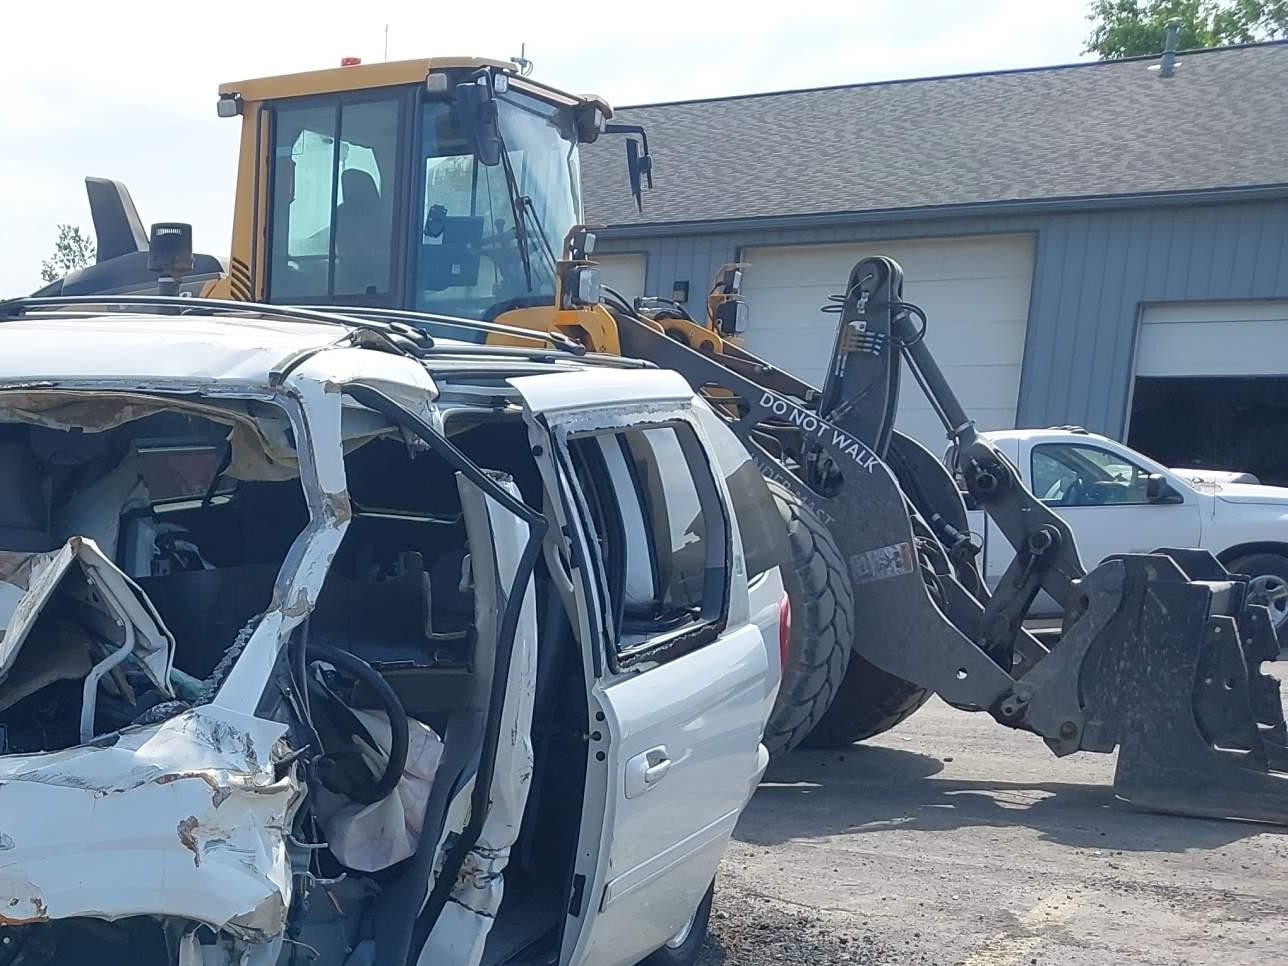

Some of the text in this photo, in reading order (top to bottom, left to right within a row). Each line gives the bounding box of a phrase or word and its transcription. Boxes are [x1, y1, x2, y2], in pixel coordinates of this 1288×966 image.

[759, 392, 879, 474] DO NOT WALK
